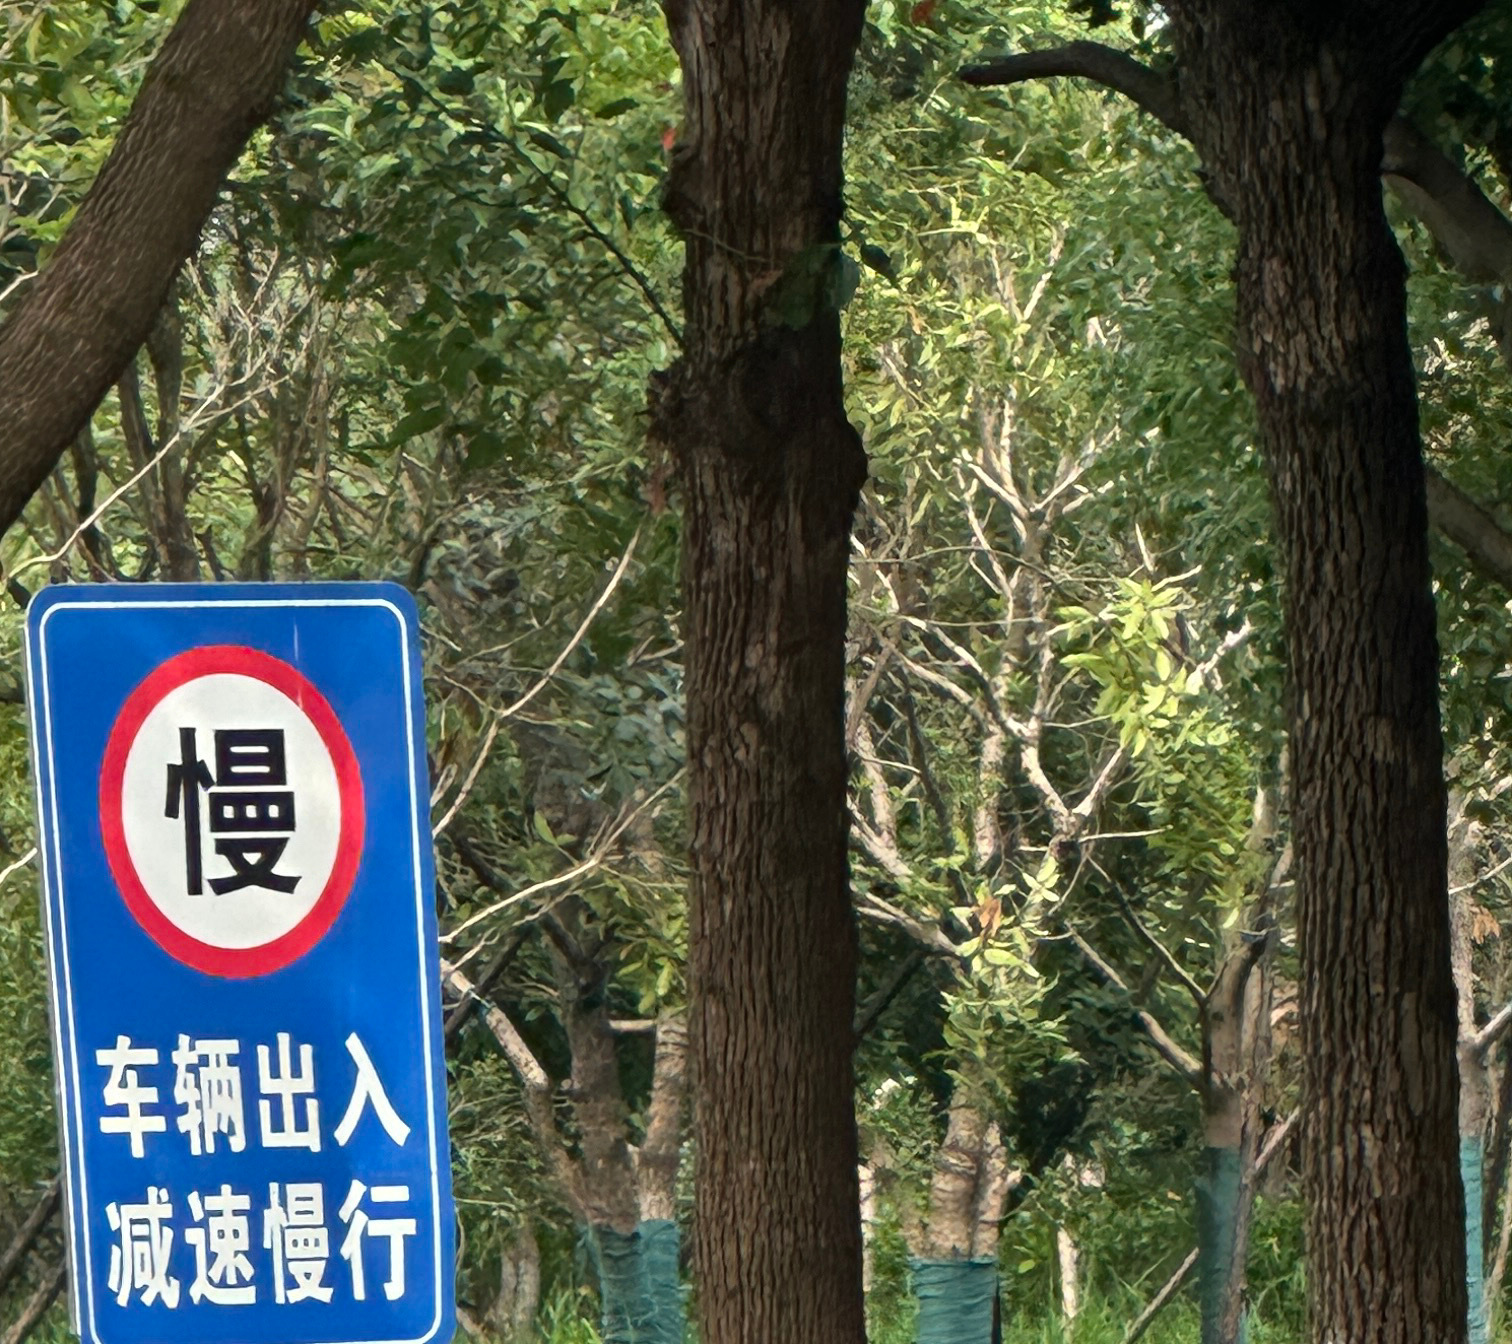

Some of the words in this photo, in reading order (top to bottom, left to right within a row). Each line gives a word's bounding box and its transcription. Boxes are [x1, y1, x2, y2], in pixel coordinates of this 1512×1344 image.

[165, 727, 301, 896] 慢
[95, 1031, 411, 1158] 车辆出入
[106, 1180, 417, 1308] 减速慢行
